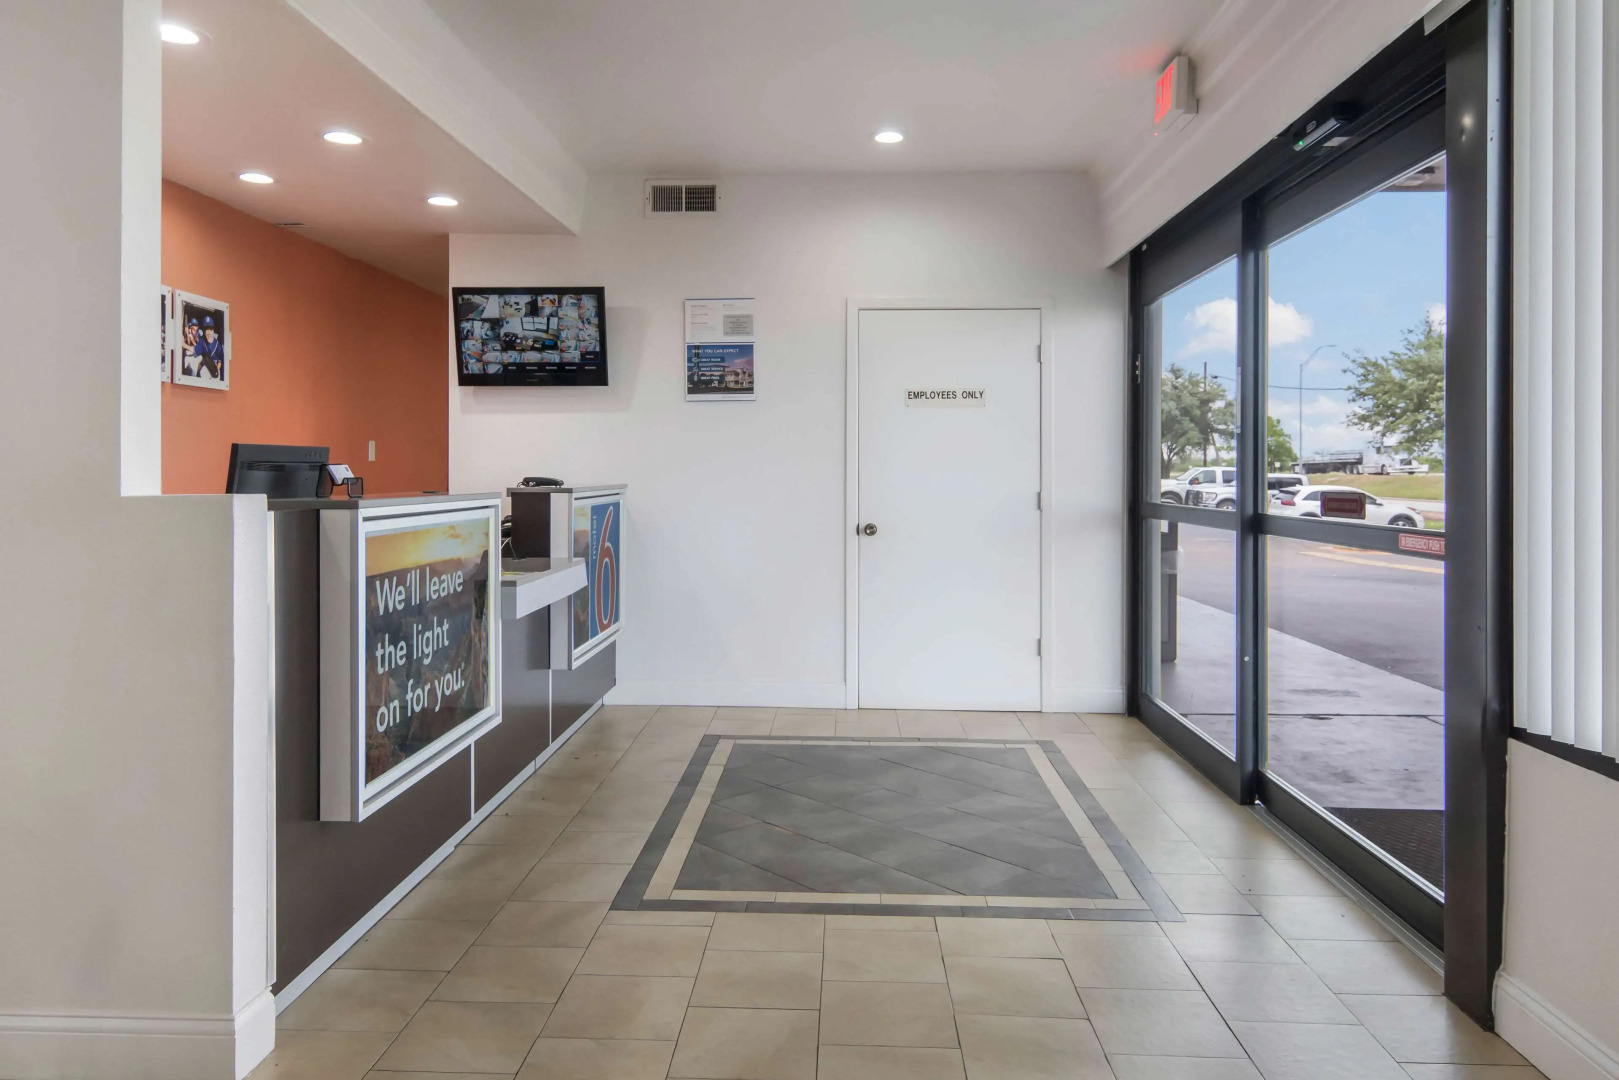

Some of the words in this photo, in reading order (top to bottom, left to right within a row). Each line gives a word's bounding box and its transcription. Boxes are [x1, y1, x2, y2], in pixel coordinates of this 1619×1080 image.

[907, 390, 957, 400] EMPLOYEES
[961, 390, 984, 399] ONLY
[375, 569, 420, 617] We'll
[426, 565, 464, 603] leave
[595, 505, 617, 635] 6
[375, 633, 407, 675] the
[413, 615, 450, 665] light
[376, 698, 401, 734] on
[405, 677, 430, 717] for
